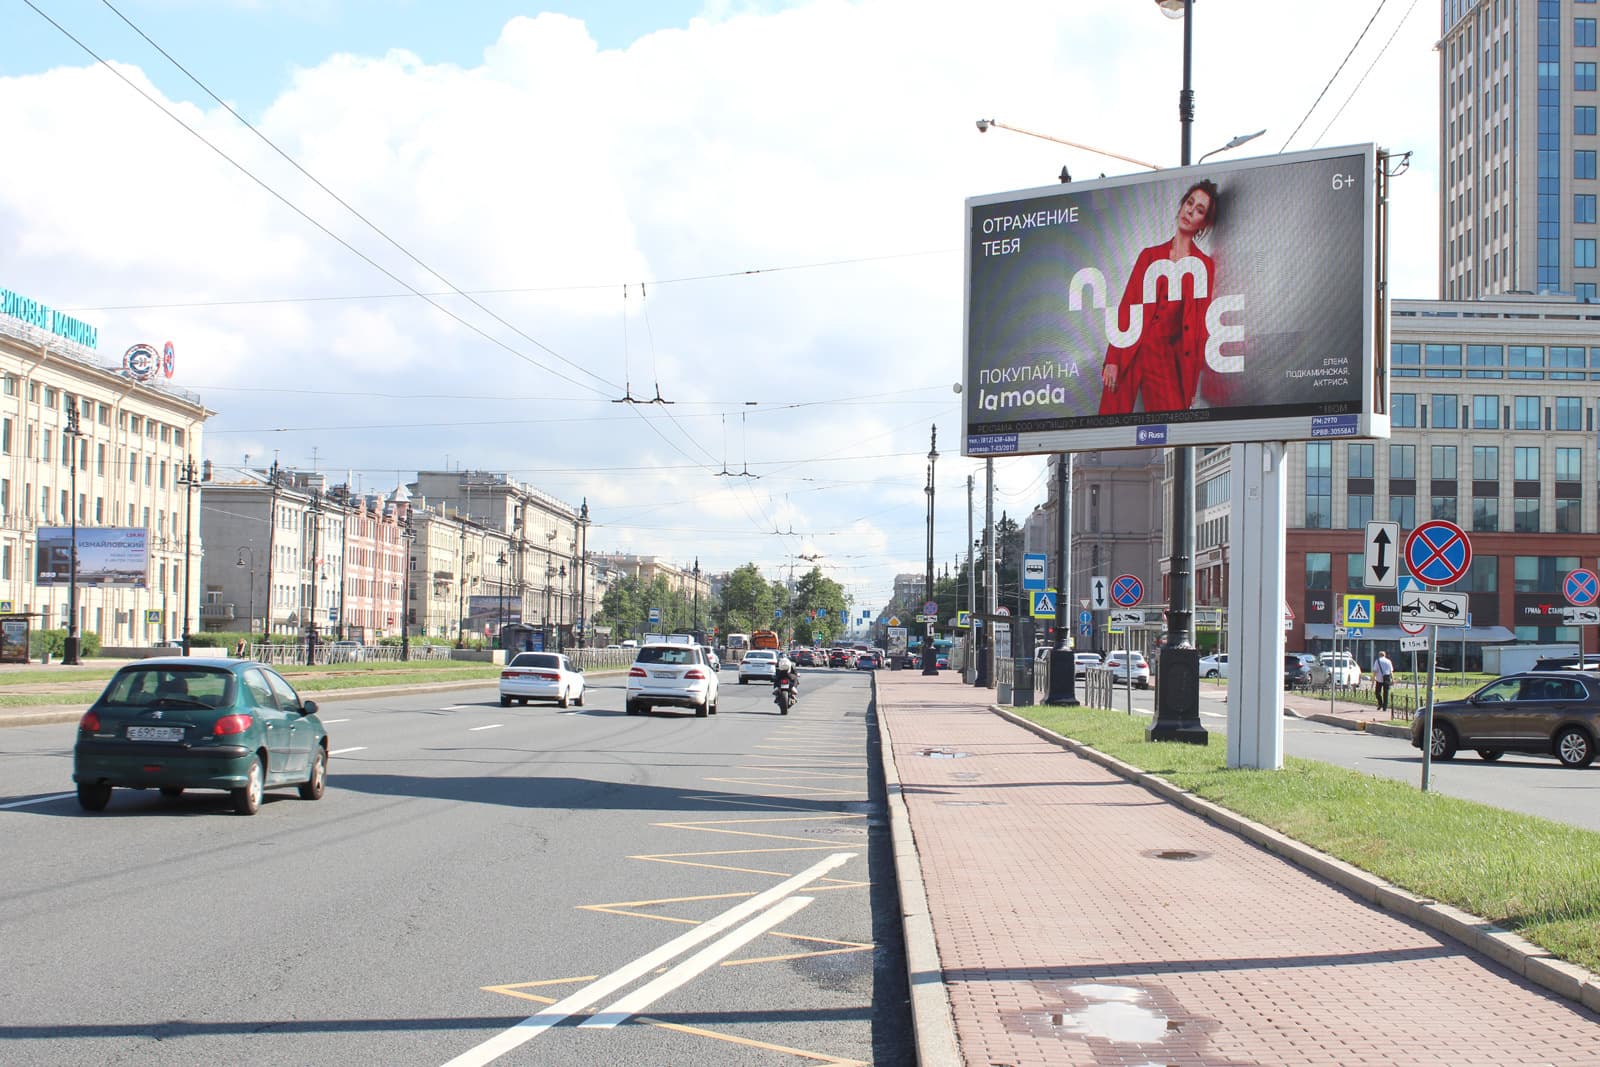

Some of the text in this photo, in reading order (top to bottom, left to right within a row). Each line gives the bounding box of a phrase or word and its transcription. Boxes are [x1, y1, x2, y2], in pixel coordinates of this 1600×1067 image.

[1332, 173, 1355, 190] 6+
[982, 206, 1080, 234] ОТРАЖЕНИЕ
[981, 237, 1021, 257] ТЕБЯ
[52, 309, 97, 350] МАШИНЫ
[1323, 357, 1349, 366] ЕЛЕНА
[980, 361, 1080, 385] ПОКУПАЙ НА
[1313, 378, 1349, 387] АКТРИСА
[978, 384, 1066, 411] lamoda
[1148, 431, 1164, 439] Russ
